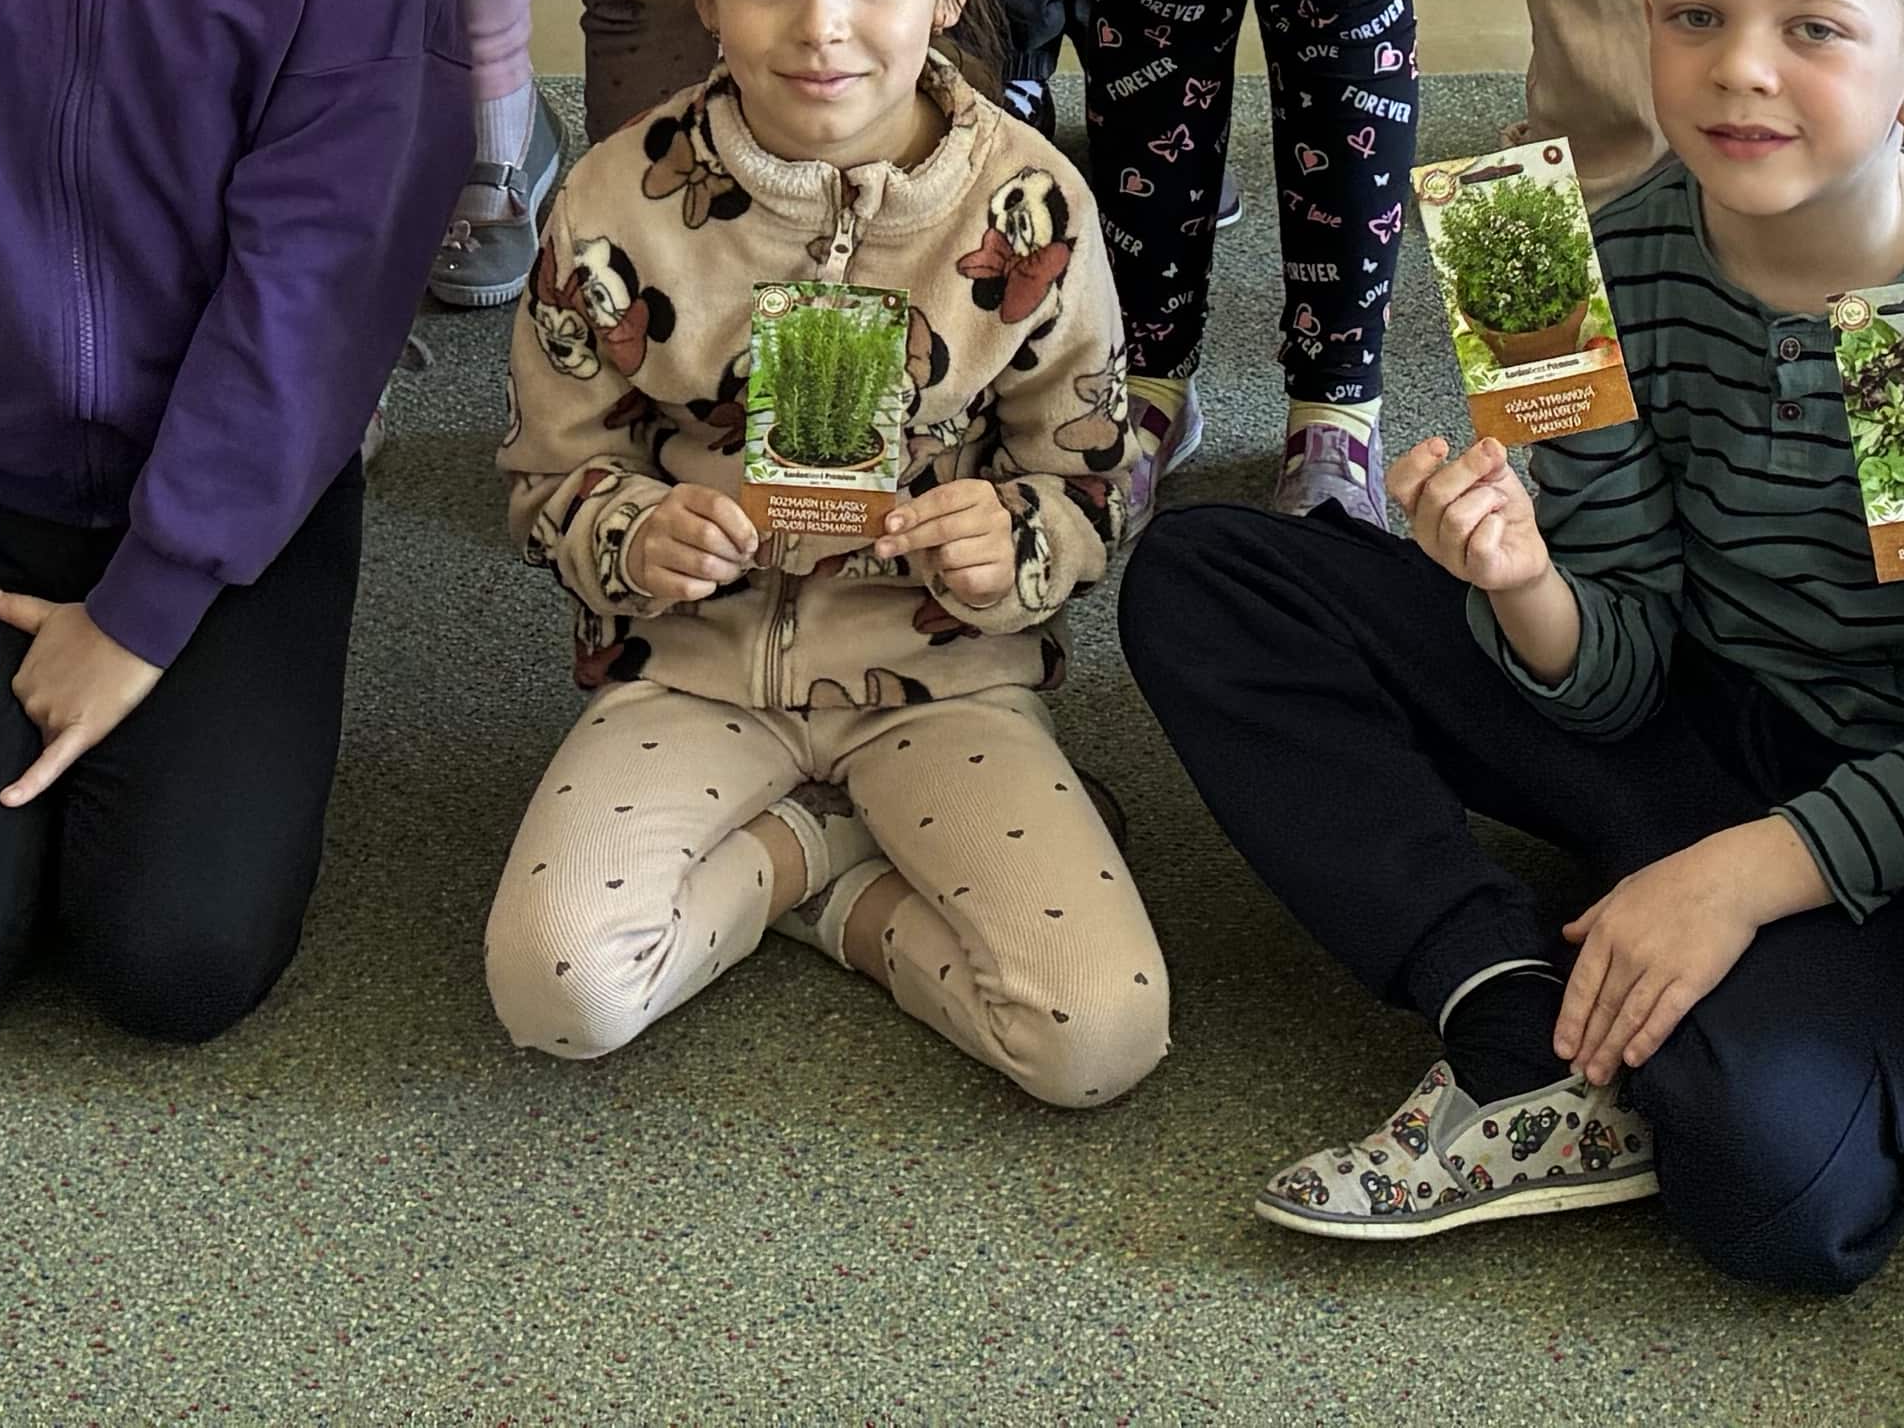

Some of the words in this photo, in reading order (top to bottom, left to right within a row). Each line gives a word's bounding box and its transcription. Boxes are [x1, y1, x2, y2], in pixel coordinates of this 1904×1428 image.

[1297, 44, 1340, 63] LOVE
[1106, 55, 1179, 102] FOREVER
[1340, 85, 1413, 124] FOREVER
[1358, 279, 1390, 309] LOVE
[1325, 384, 1364, 403] LOVE
